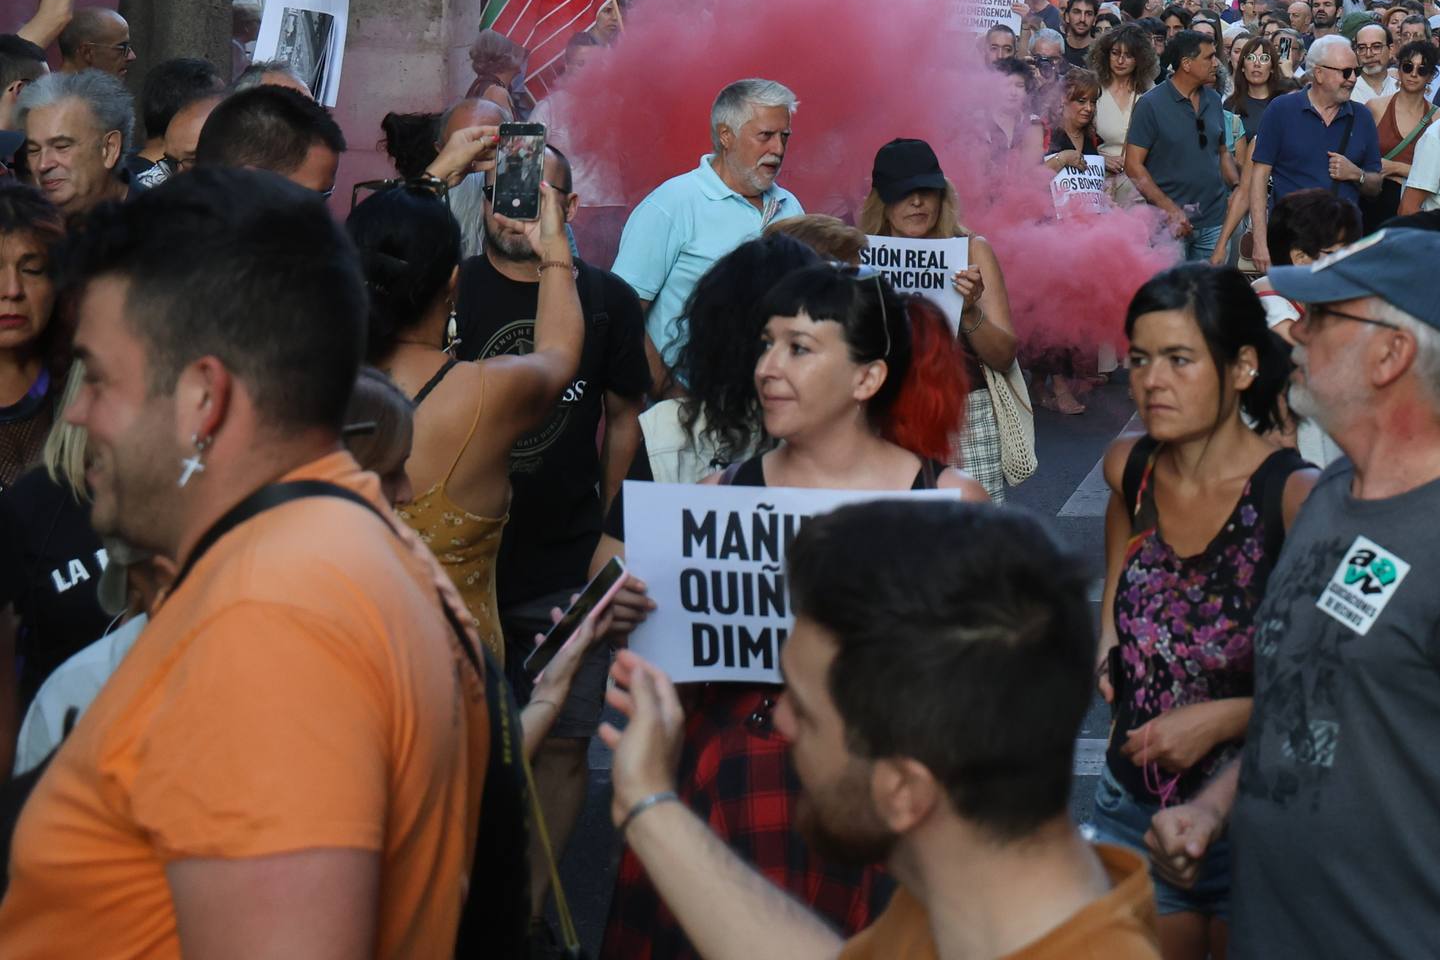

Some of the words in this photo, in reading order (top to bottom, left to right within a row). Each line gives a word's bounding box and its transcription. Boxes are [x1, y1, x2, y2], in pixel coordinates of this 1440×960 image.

[860, 244, 901, 268] SIÓN
[905, 249, 949, 269] REAL
[881, 269, 944, 289] ENCIÓN
[51, 559, 90, 593] LA
[680, 564, 798, 618] QUIÑ
